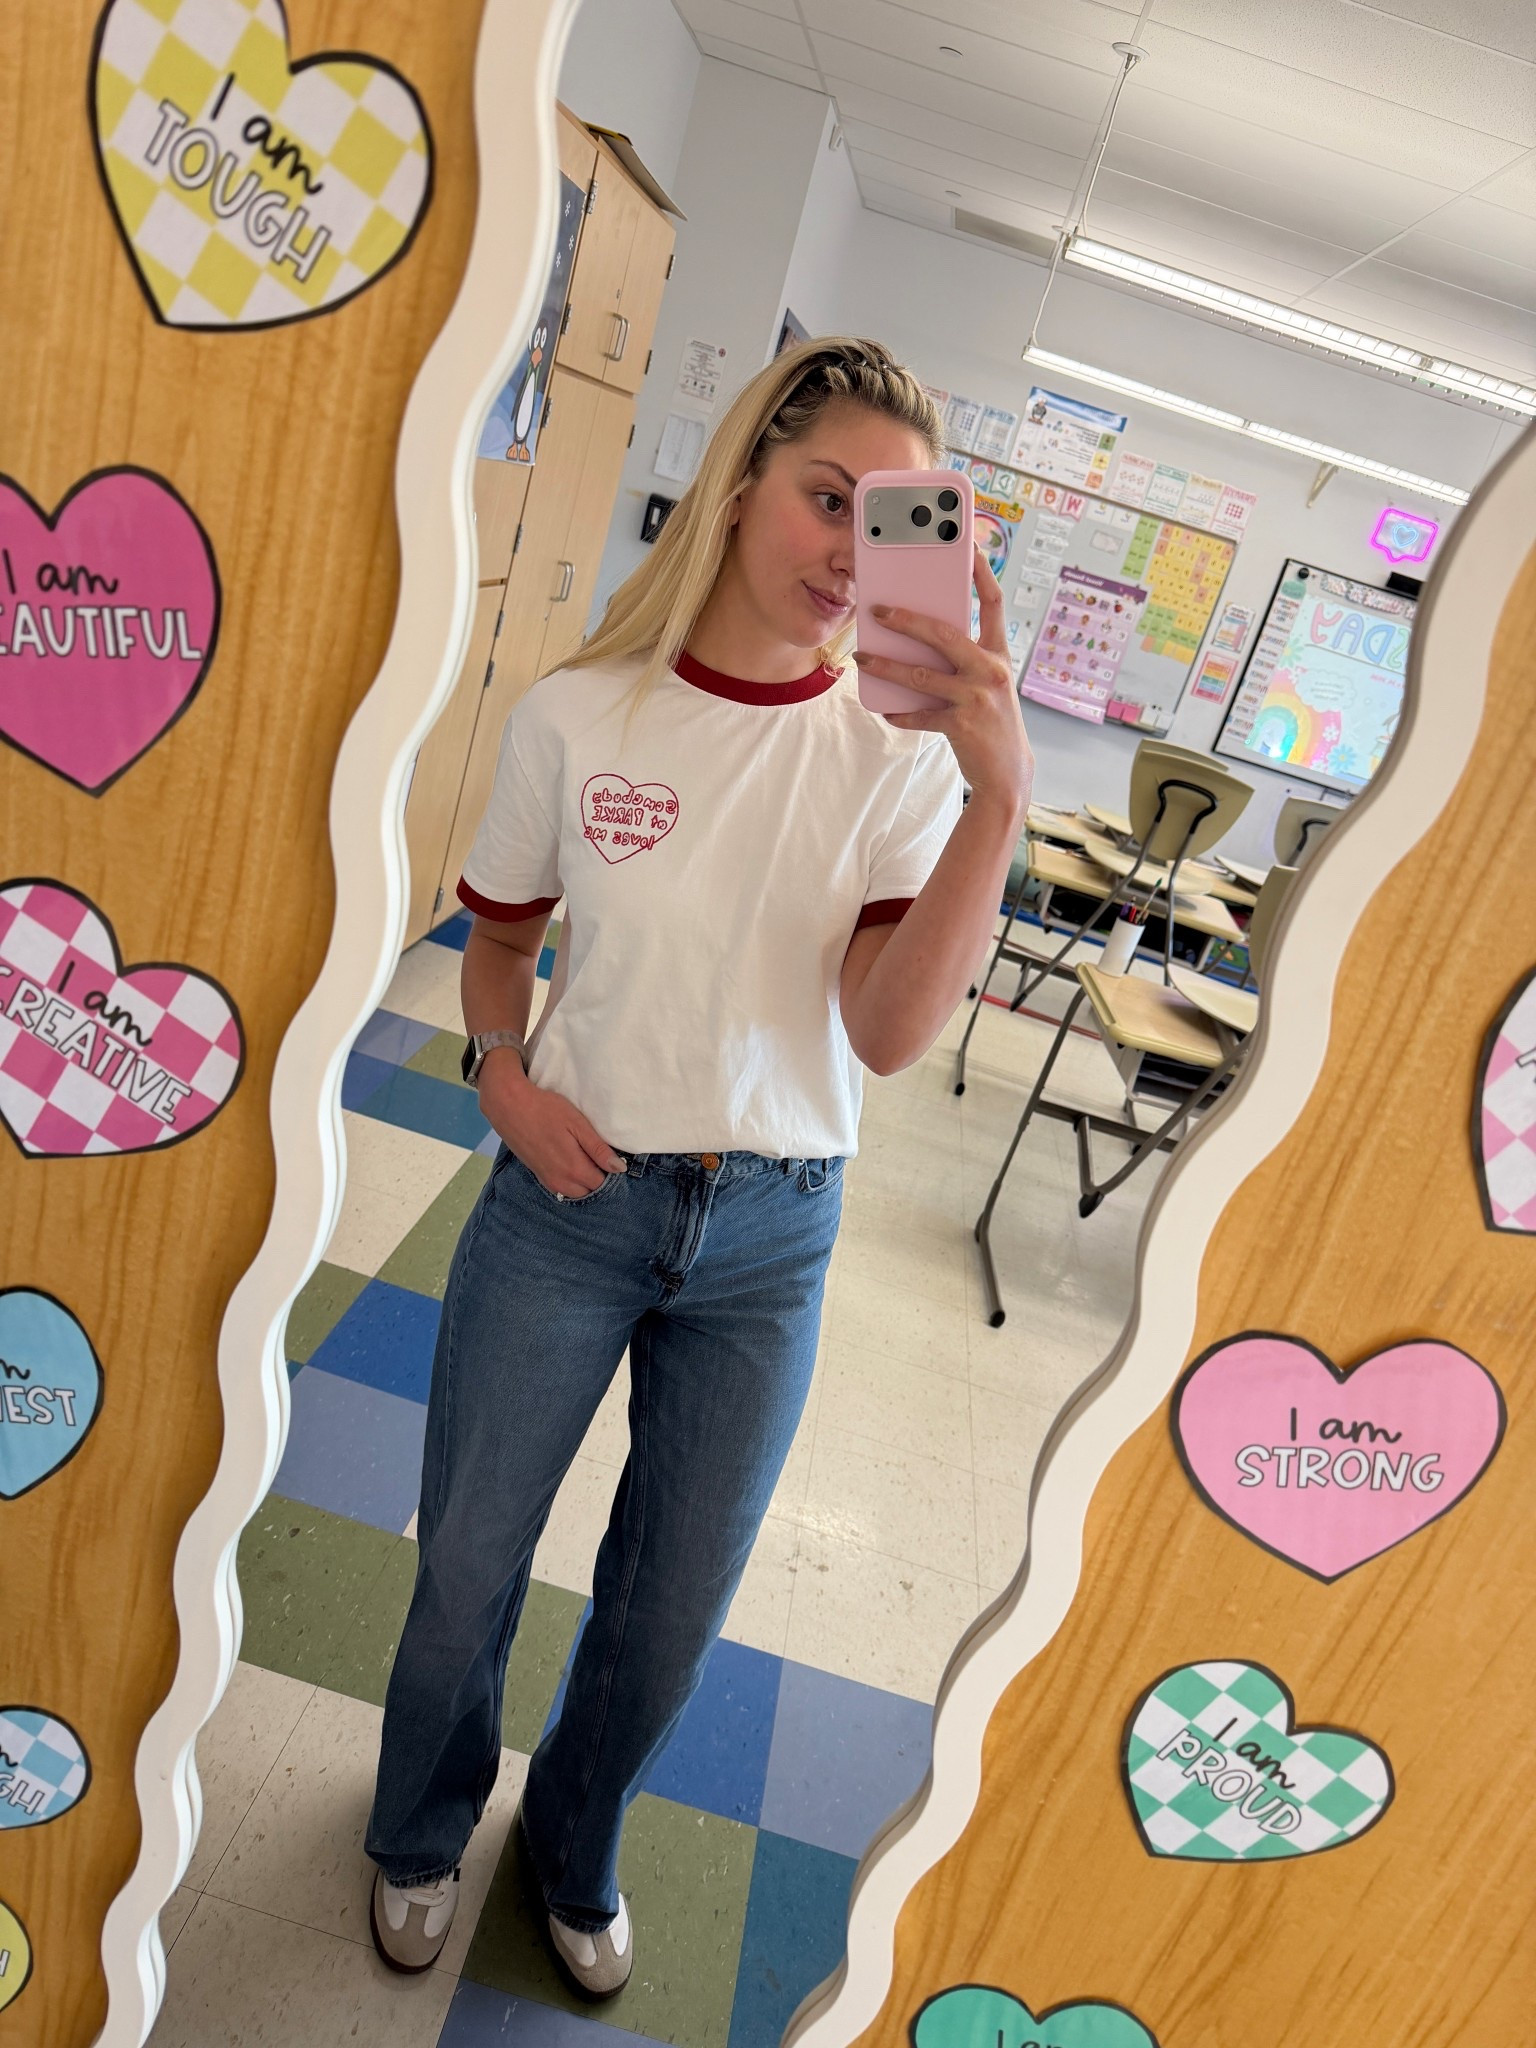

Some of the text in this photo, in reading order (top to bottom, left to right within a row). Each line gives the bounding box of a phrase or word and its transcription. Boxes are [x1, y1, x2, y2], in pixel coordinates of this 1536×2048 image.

[211, 73, 325, 195] I am
[144, 99, 332, 284] TOUGH
[4, 548, 119, 595] I am
[57, 960, 152, 1047] I am
[0, 1385, 76, 1426] EST
[1290, 1407, 1402, 1443] I am
[1235, 1444, 1445, 1493] STRONG
[1155, 1728, 1302, 1835] PROUD
[1213, 1717, 1296, 1790] I am
